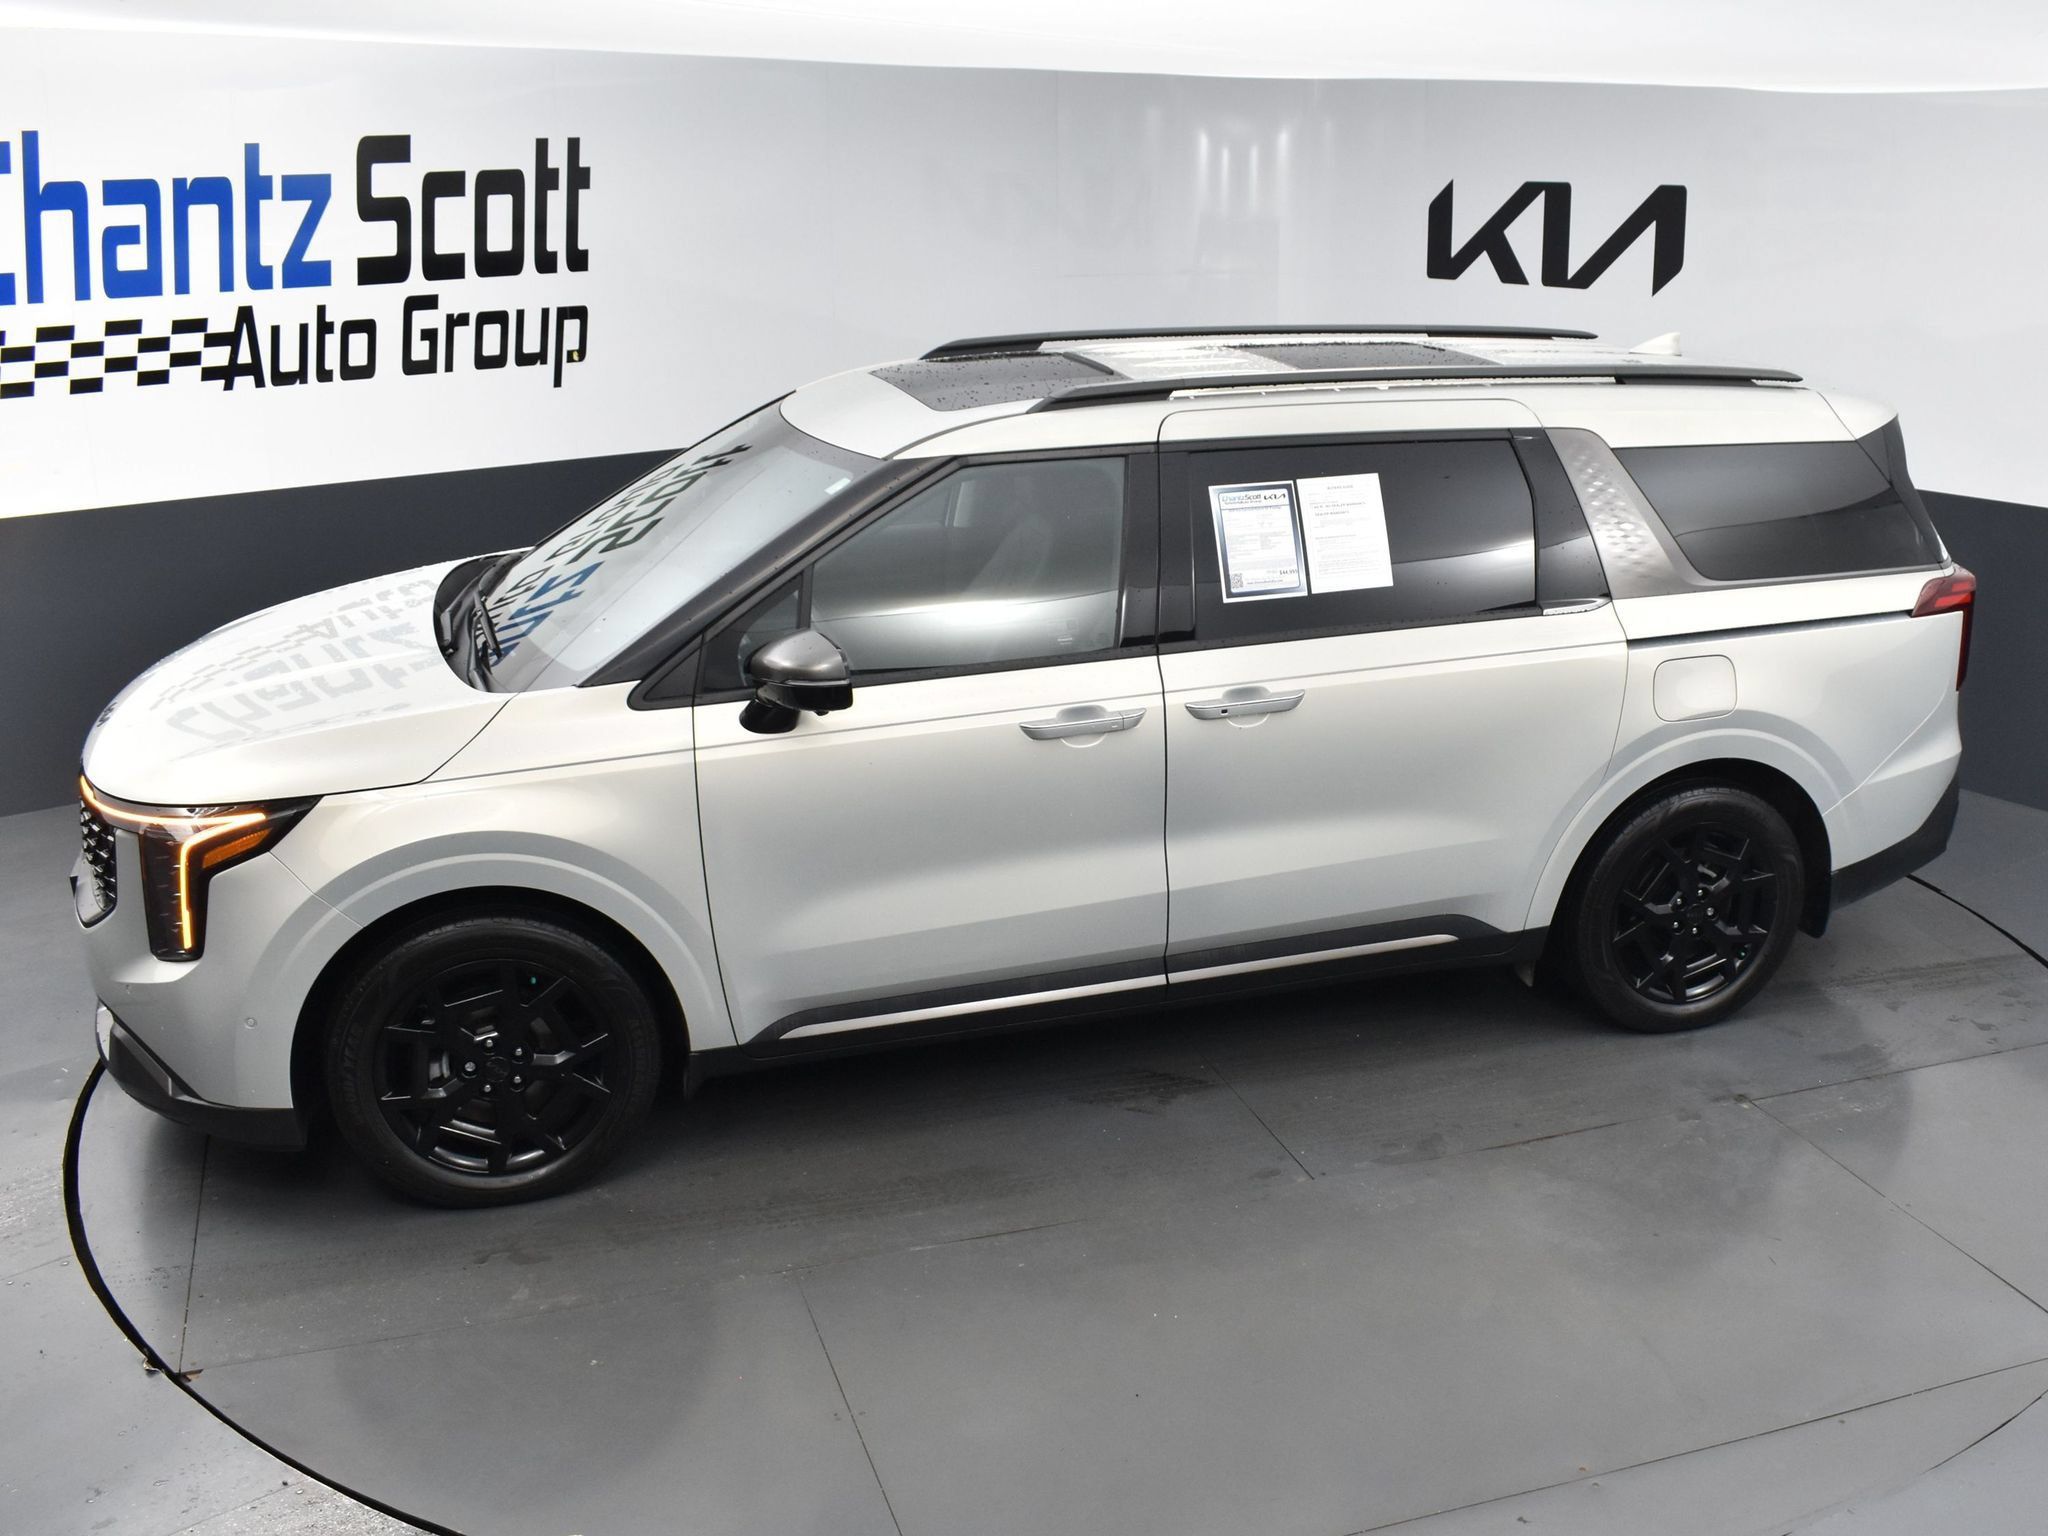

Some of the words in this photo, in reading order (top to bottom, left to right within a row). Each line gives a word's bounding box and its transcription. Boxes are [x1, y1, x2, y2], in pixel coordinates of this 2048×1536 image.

[0, 130, 332, 305] hantz
[356, 134, 591, 286] Scott
[1426, 179, 1687, 297] KIA
[222, 304, 377, 391] Auto
[401, 294, 588, 388] Group
